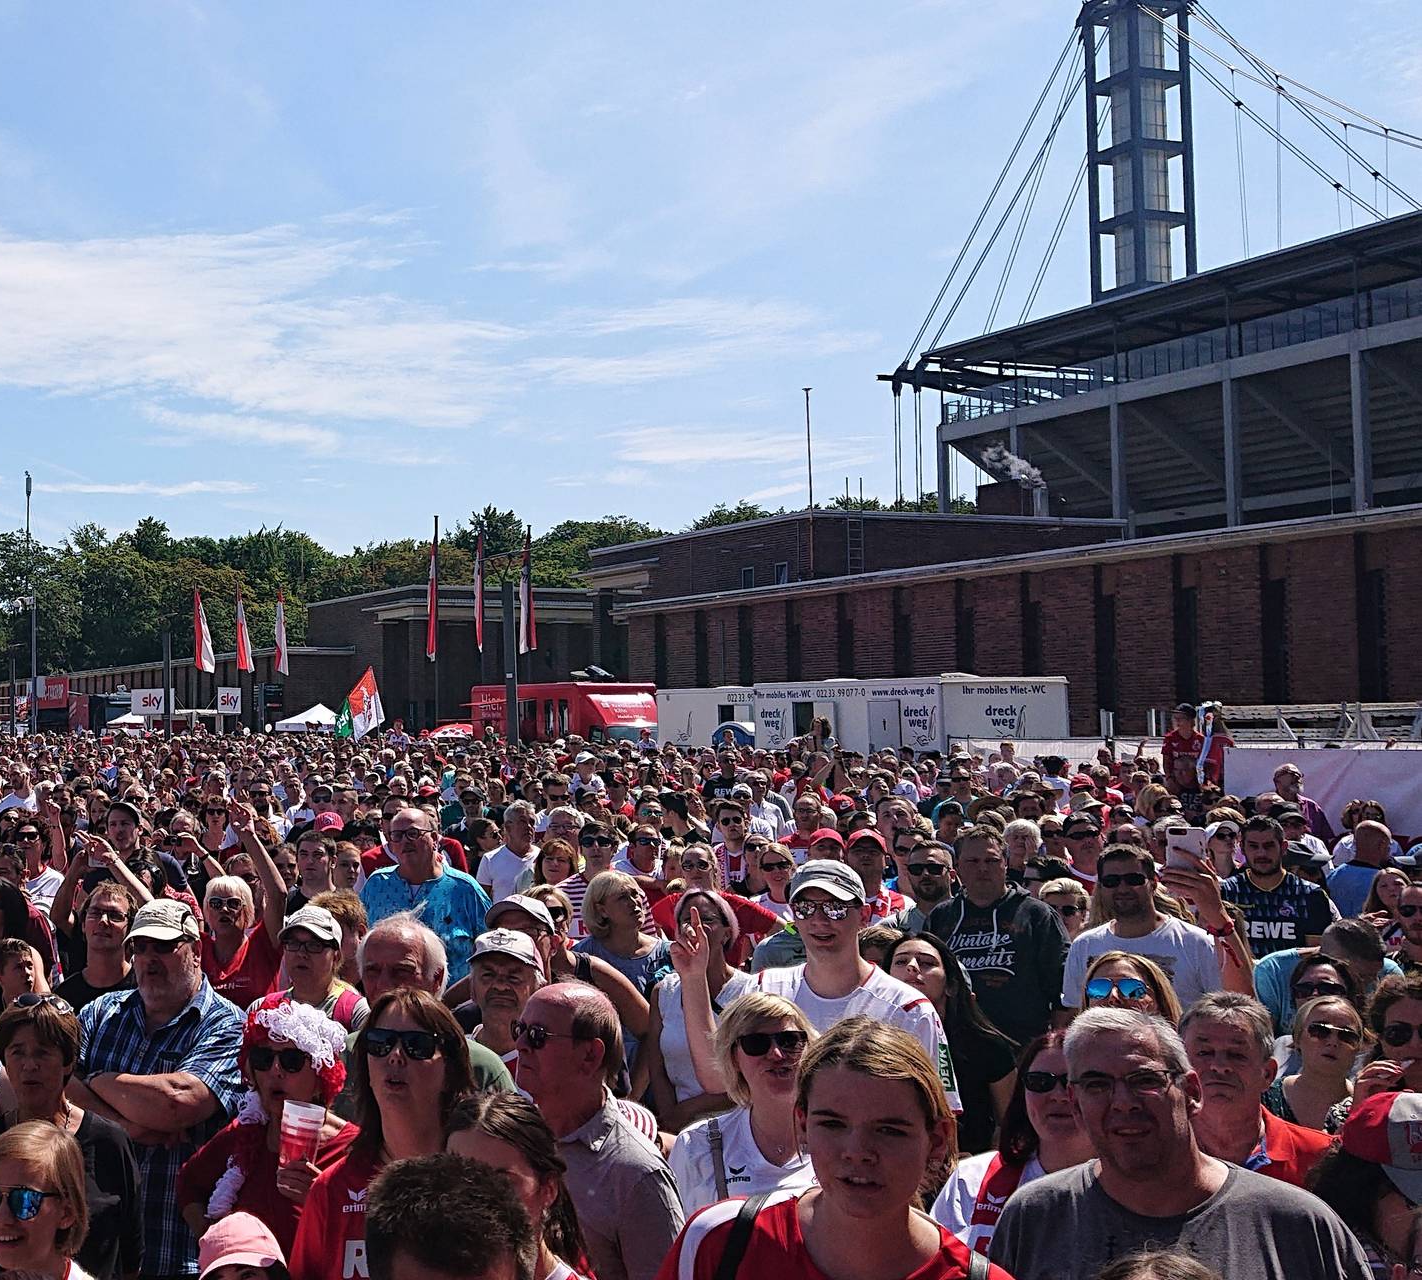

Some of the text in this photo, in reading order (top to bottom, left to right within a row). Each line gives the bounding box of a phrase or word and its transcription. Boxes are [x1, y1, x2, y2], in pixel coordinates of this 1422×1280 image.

[766, 690, 786, 698] mobiles
[787, 690, 811, 698] Miet-WC
[871, 687, 935, 698] www.dreck-weg.de
[962, 685, 1046, 694] Ihr mobiles Miet-WC
[141, 693, 163, 710] sky
[220, 692, 239, 710] sky
[760, 708, 781, 719] dreck
[903, 705, 929, 717] dreck
[985, 704, 1017, 716] dreck
[764, 719, 780, 731] weg
[908, 718, 928, 730] weg
[991, 717, 1015, 730] weg
[939, 1048, 952, 1088] DEVK
[342, 1202, 367, 1213] erim
[976, 1203, 1001, 1214] erim
